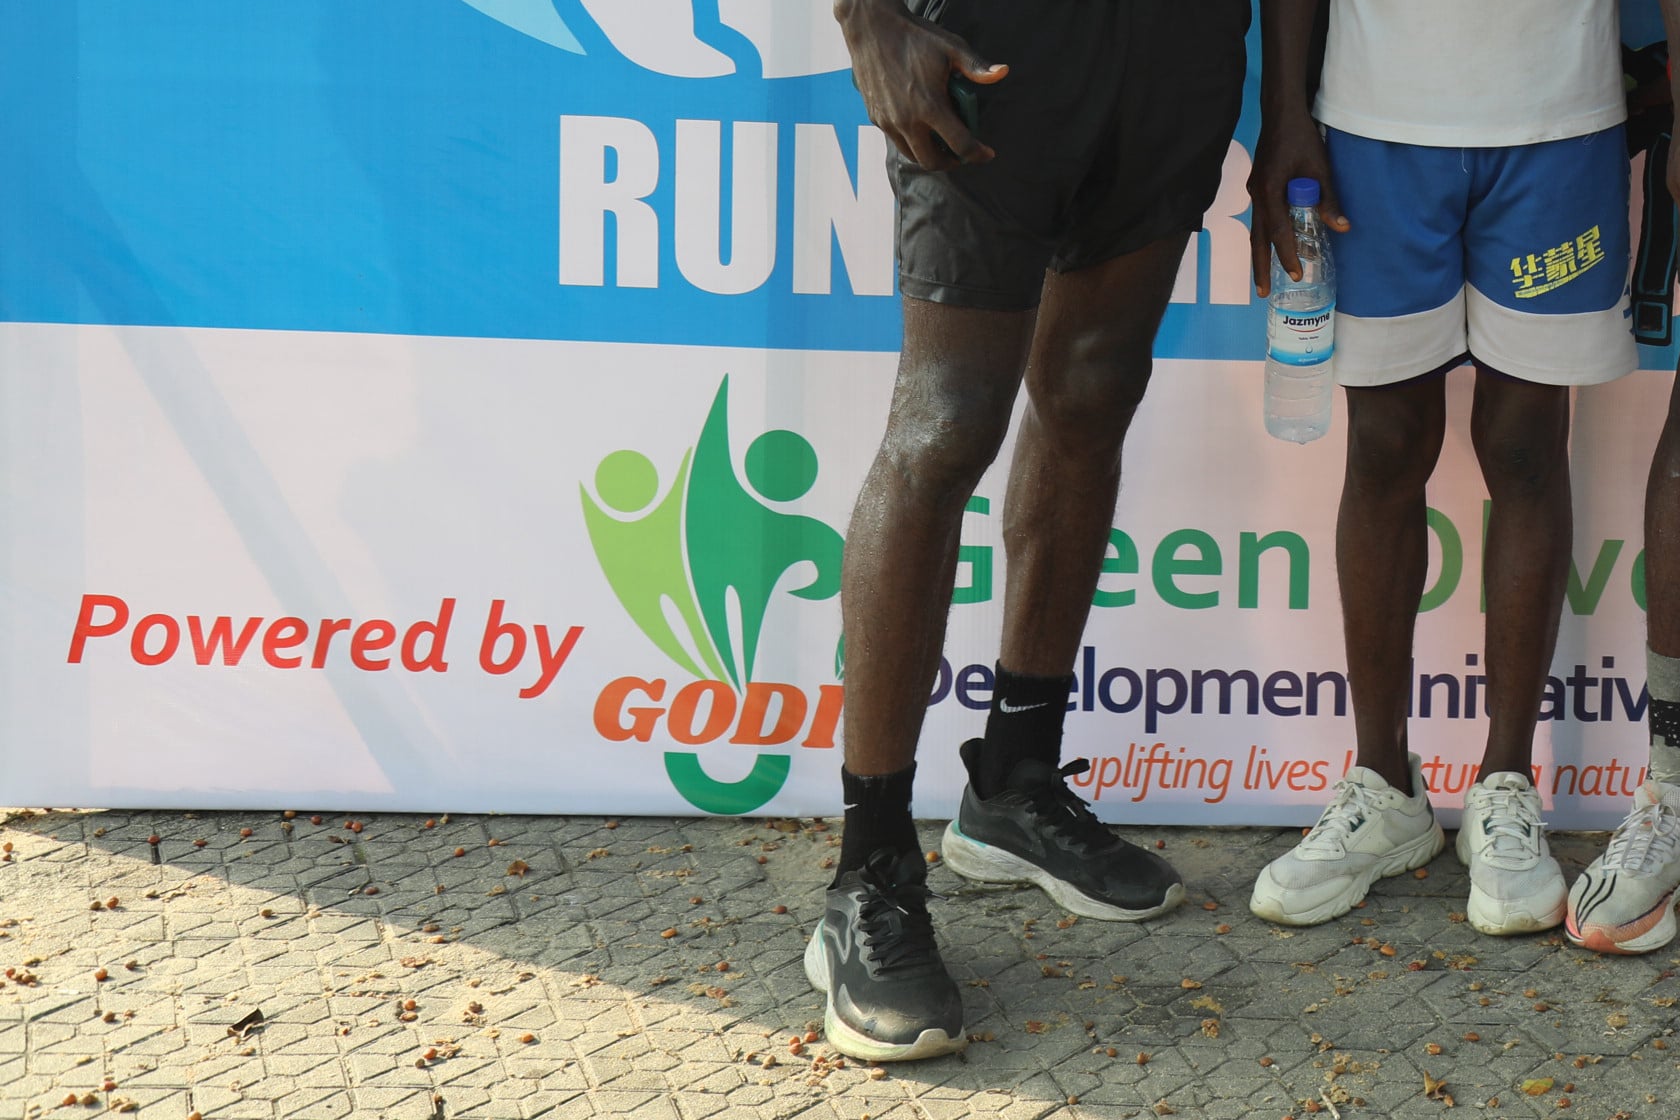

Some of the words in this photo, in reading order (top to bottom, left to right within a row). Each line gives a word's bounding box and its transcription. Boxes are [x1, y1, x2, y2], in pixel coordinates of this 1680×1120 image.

[558, 115, 896, 297] RUN
[1283, 312, 1330, 327] Jazmyne
[949, 495, 1311, 610] een
[66, 594, 457, 675] Powered
[477, 599, 585, 699] by
[928, 645, 1350, 734] elopmen
[1242, 745, 1330, 792] lives
